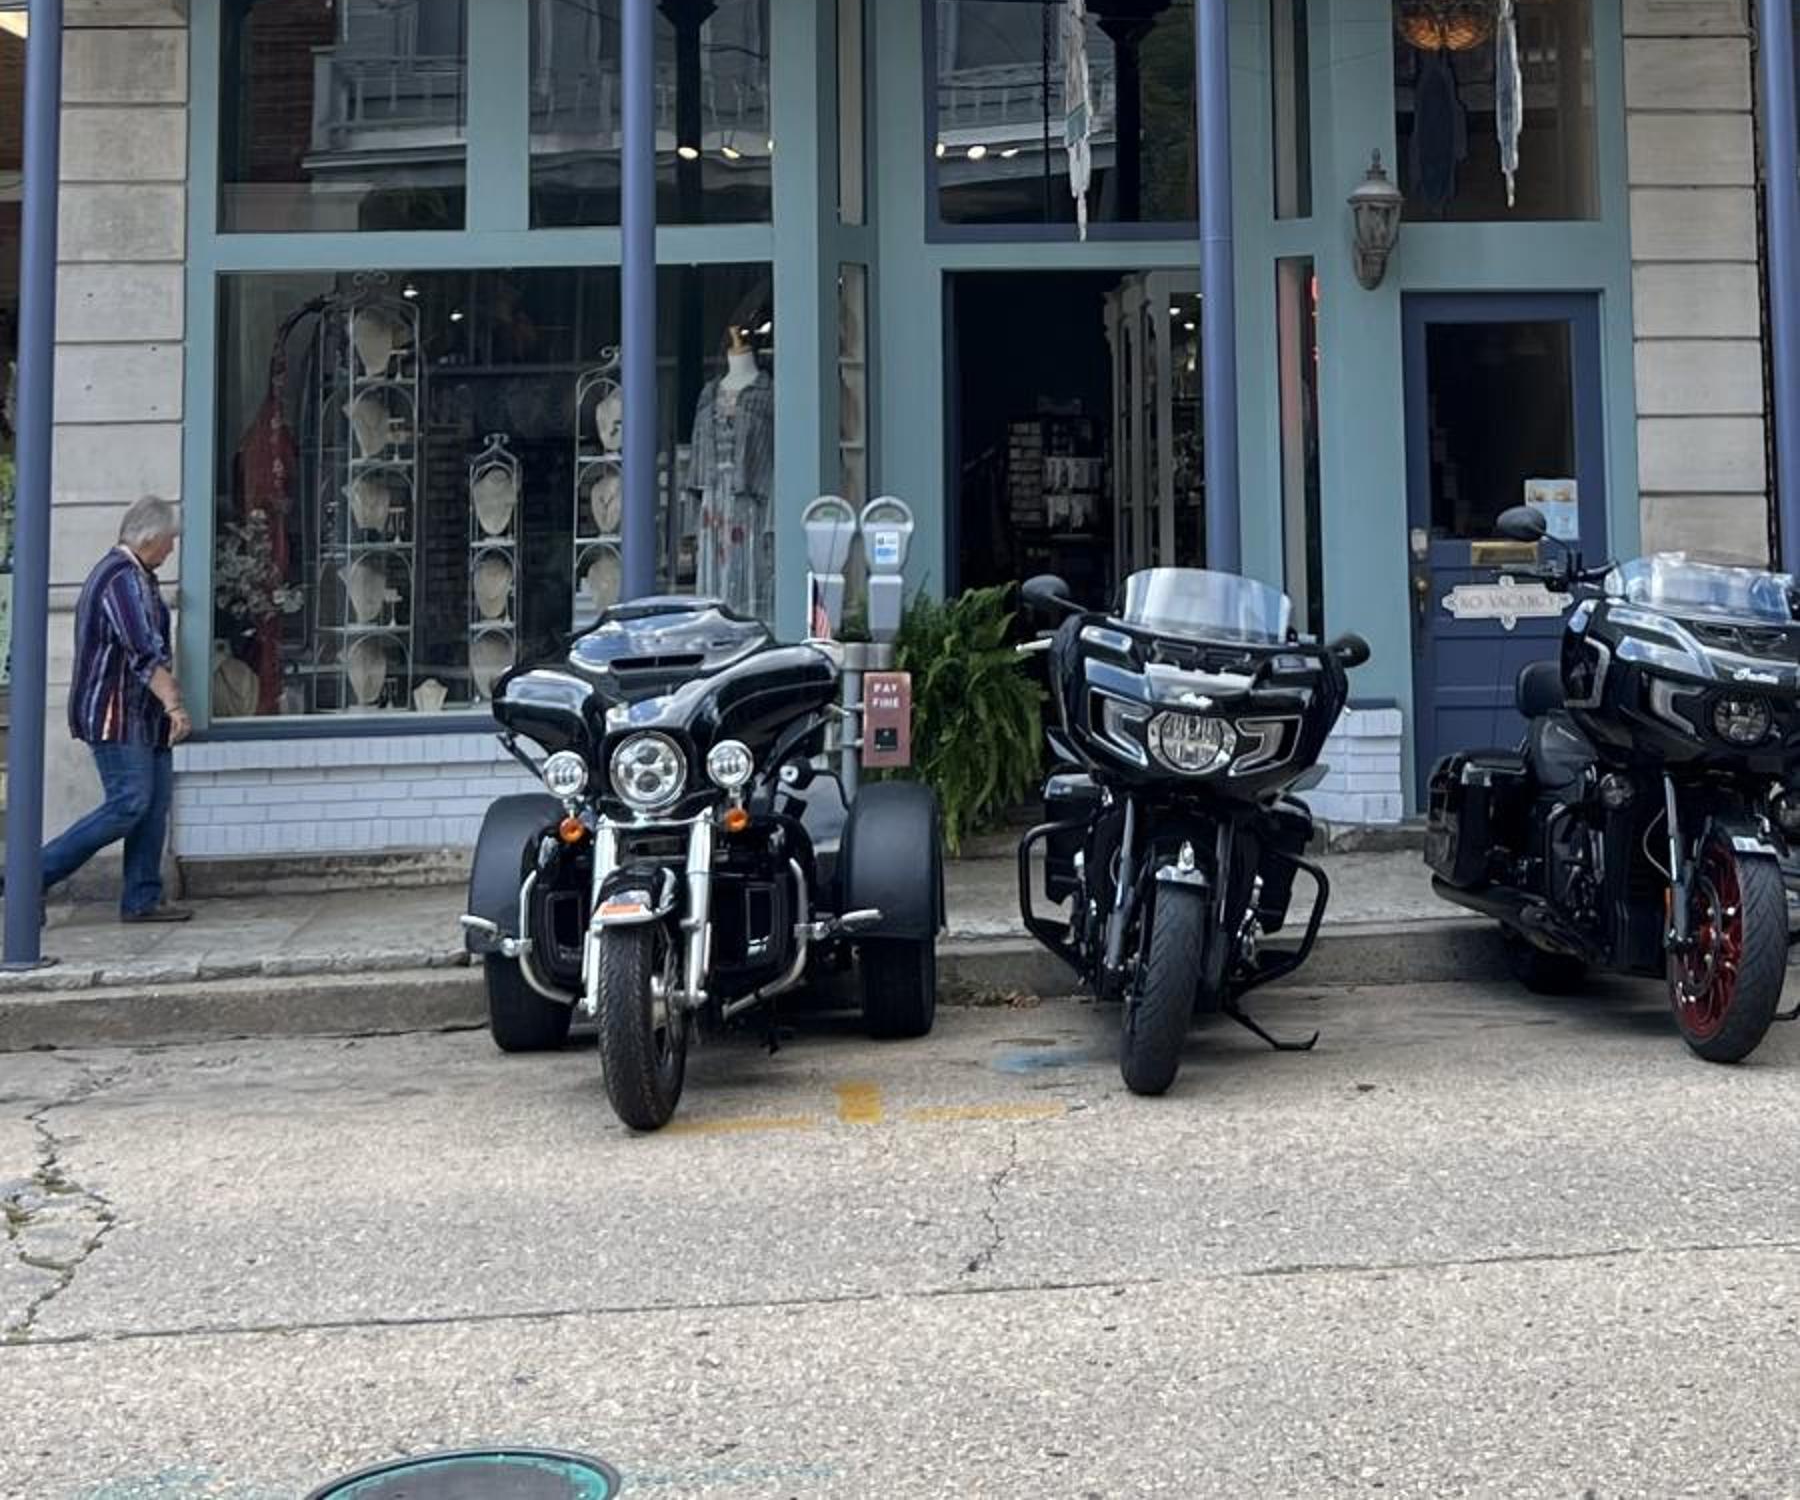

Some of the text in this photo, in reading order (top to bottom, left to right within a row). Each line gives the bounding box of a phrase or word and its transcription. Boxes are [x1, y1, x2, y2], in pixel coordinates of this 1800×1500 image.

[1460, 595, 1483, 610] NO
[873, 683, 897, 693] PAY
[872, 697, 899, 708] FINE
